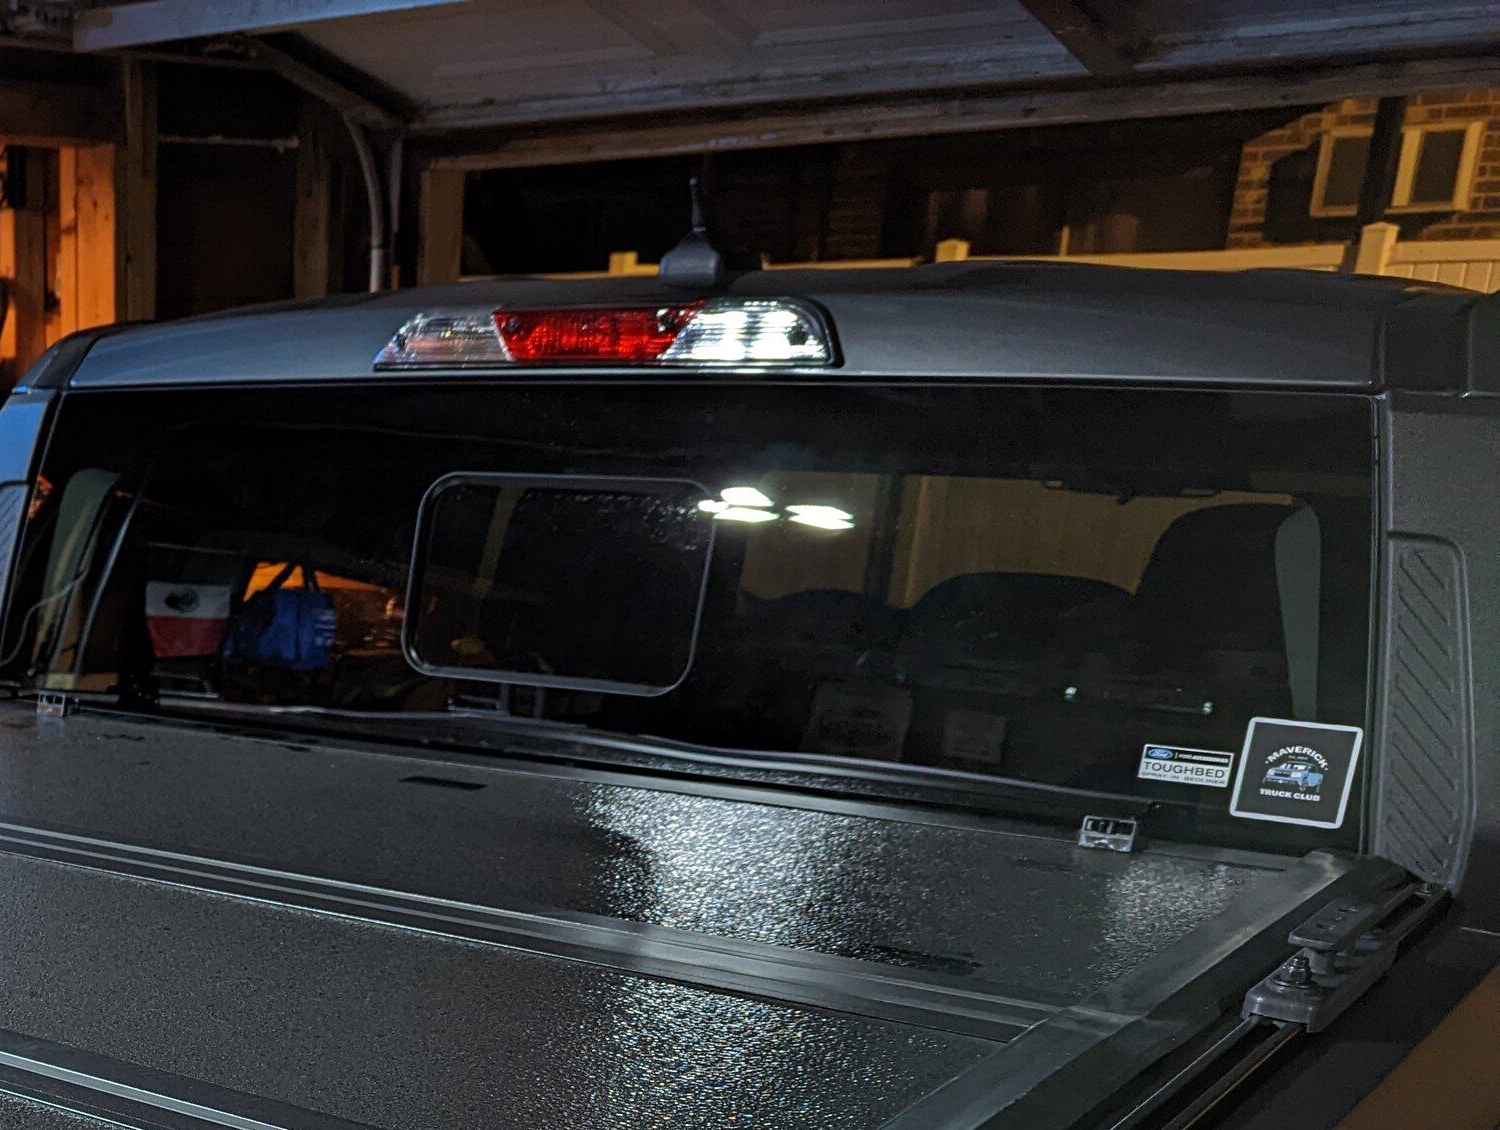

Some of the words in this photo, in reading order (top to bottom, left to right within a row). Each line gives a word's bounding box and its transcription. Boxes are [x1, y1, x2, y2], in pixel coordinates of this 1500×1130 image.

[1266, 745, 1328, 769] MAVERICK
[1143, 761, 1226, 779] TOUGHBED
[1260, 788, 1292, 799] TRUCK
[1293, 792, 1321, 802] CLUB
